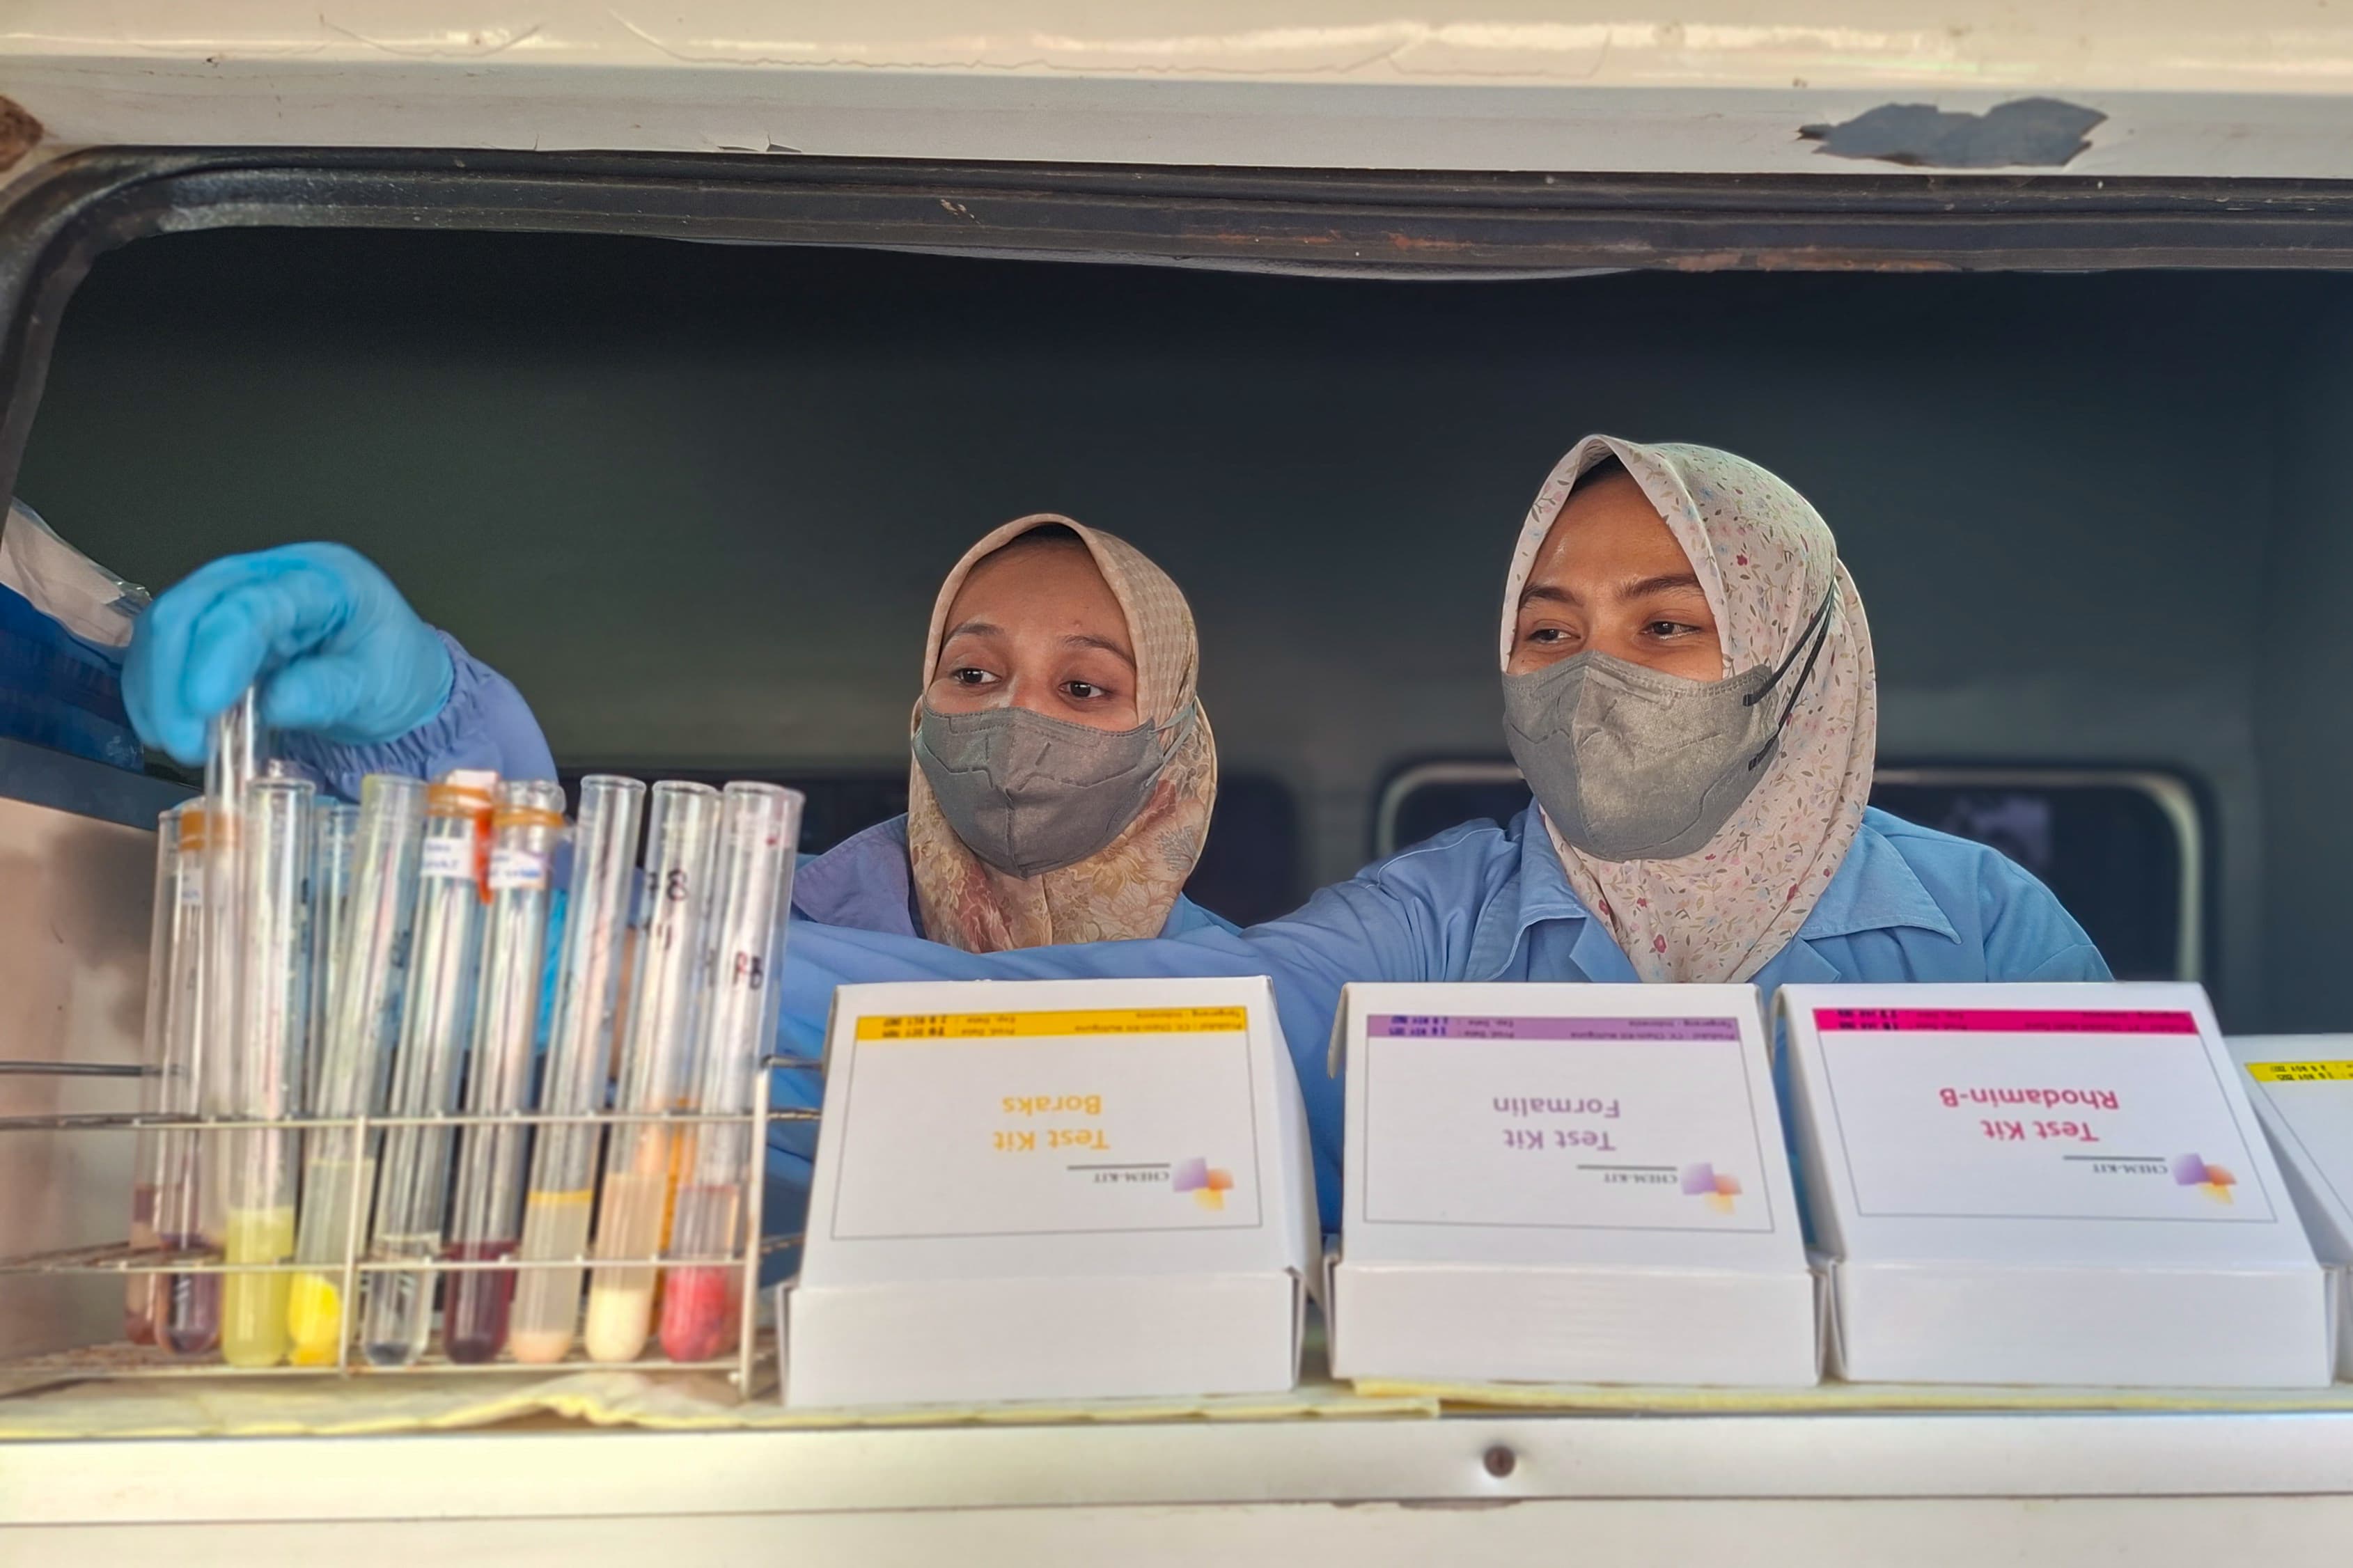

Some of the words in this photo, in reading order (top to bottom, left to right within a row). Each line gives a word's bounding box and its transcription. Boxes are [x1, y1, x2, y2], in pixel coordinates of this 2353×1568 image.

[1002, 1095, 1102, 1117] Boraks
[1493, 1098, 1620, 1118] Formalin
[1939, 1088, 2119, 1110] Rhodamin-B
[1047, 1129, 1109, 1151] Test
[1503, 1129, 1543, 1150] Kit
[1980, 1120, 2025, 1140] Kit
[2033, 1121, 2099, 1141] Test
[993, 1131, 1036, 1152] Kit
[1554, 1130, 1616, 1151] Test
[1093, 1171, 1169, 1183] CHEM-KIT
[2093, 1163, 2168, 1174] CHEM-KIT
[1603, 1174, 1678, 1184] CHEM-KIT
